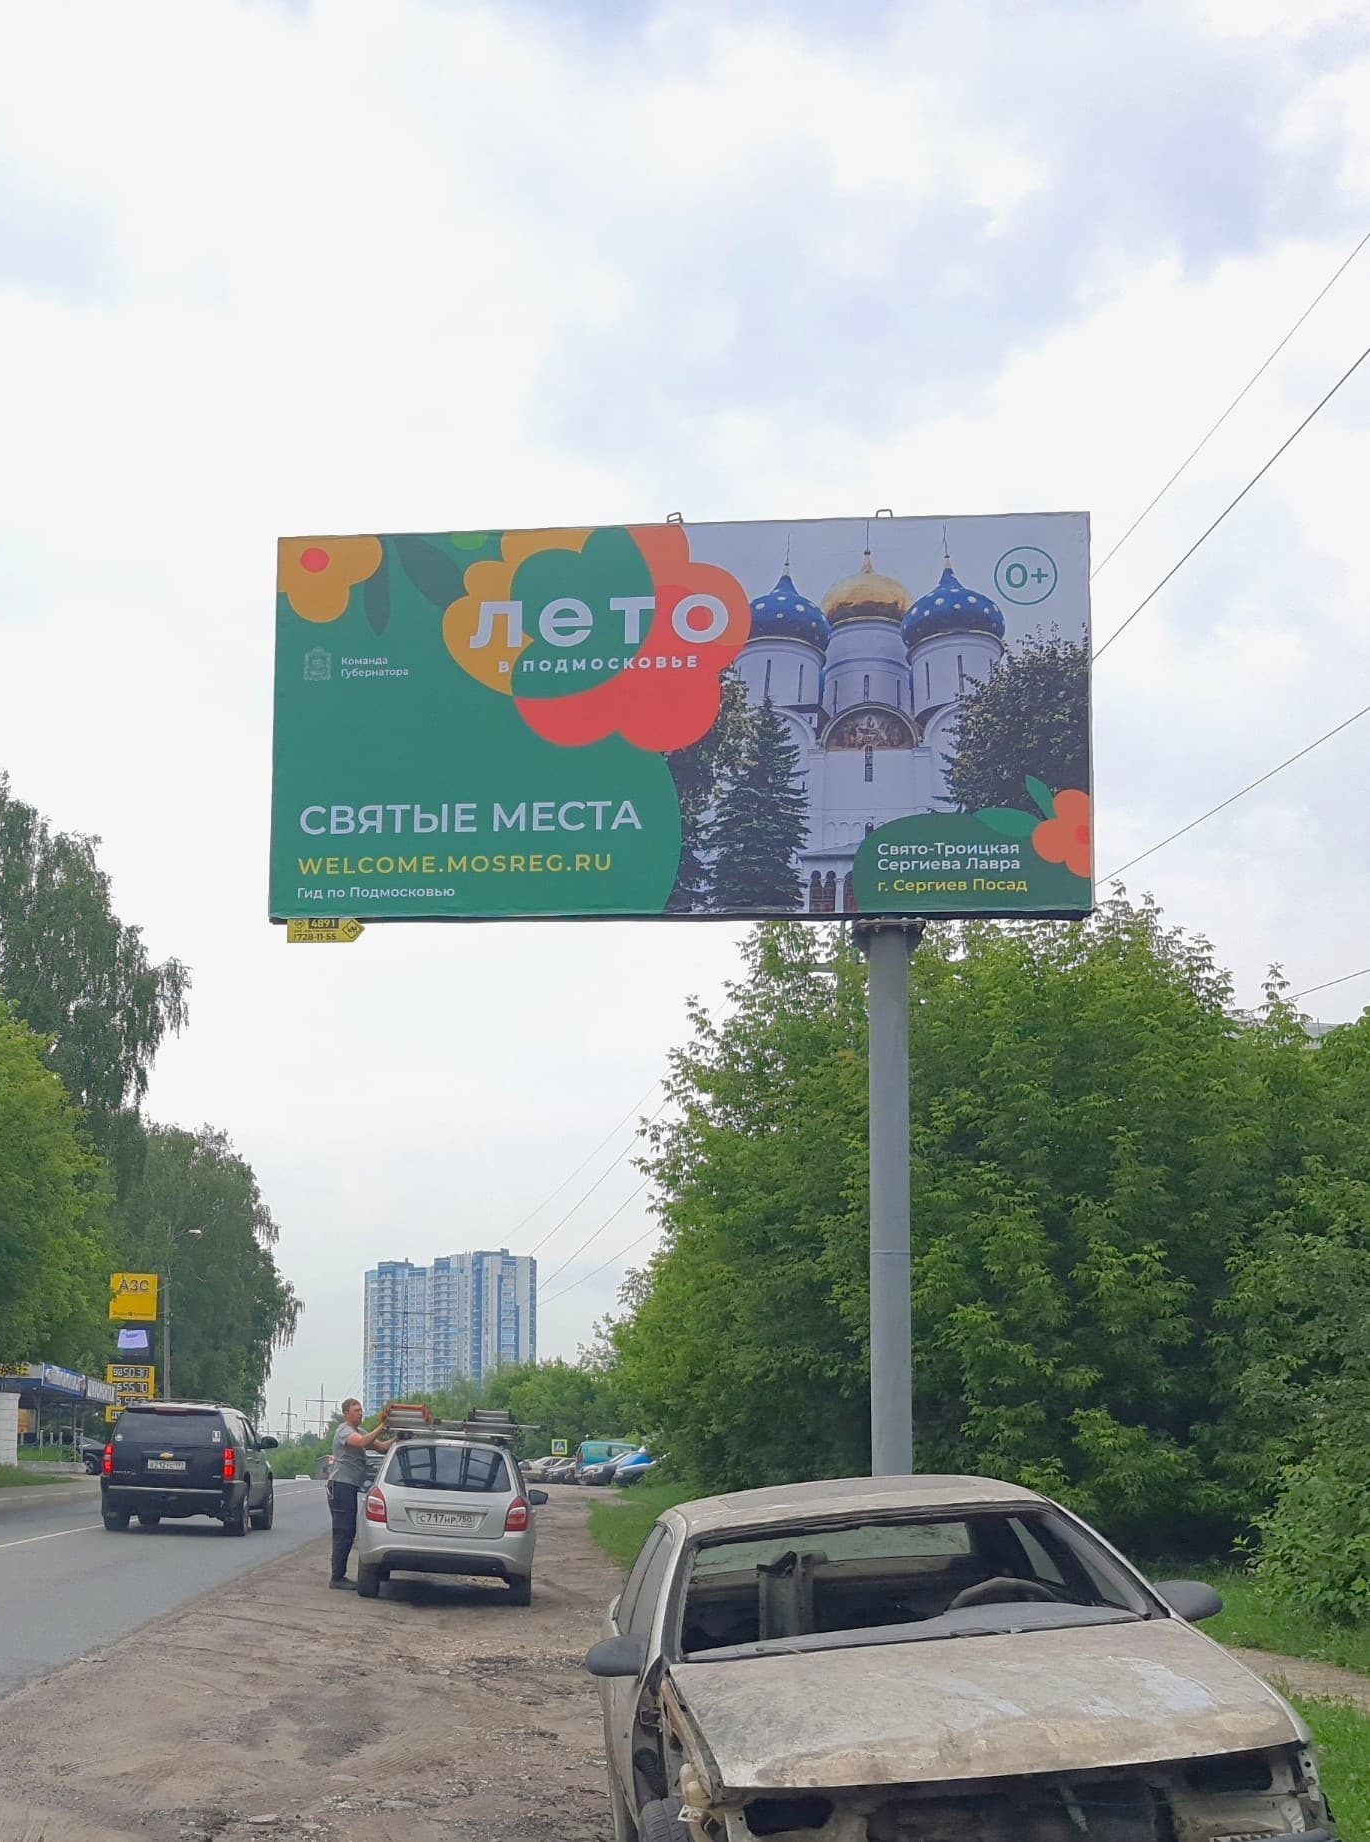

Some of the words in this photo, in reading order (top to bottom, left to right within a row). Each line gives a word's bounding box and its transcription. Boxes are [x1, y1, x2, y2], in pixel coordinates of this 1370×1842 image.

[1006, 562, 1049, 588] 0+
[470, 593, 729, 649] лето
[341, 656, 388, 666] Команда
[522, 655, 699, 674] ПОДМОСКОВЬЕ
[341, 667, 409, 679] Губернатора
[299, 802, 478, 835] СВЯТЫЕ
[492, 800, 643, 832] МЕСТА
[877, 842, 1020, 857] Свято-Троицкая
[298, 853, 612, 875] WELCOME.MOSREG.RU
[877, 858, 961, 873] Сергиева
[965, 857, 1021, 872] Лавра
[297, 887, 324, 900] Гид
[328, 888, 346, 899] по
[349, 886, 456, 899] Подмосковью
[877, 881, 889, 892] г.
[893, 879, 967, 894] Сергиев
[973, 878, 1028, 893] Посад
[119, 1279, 150, 1291] АЗС
